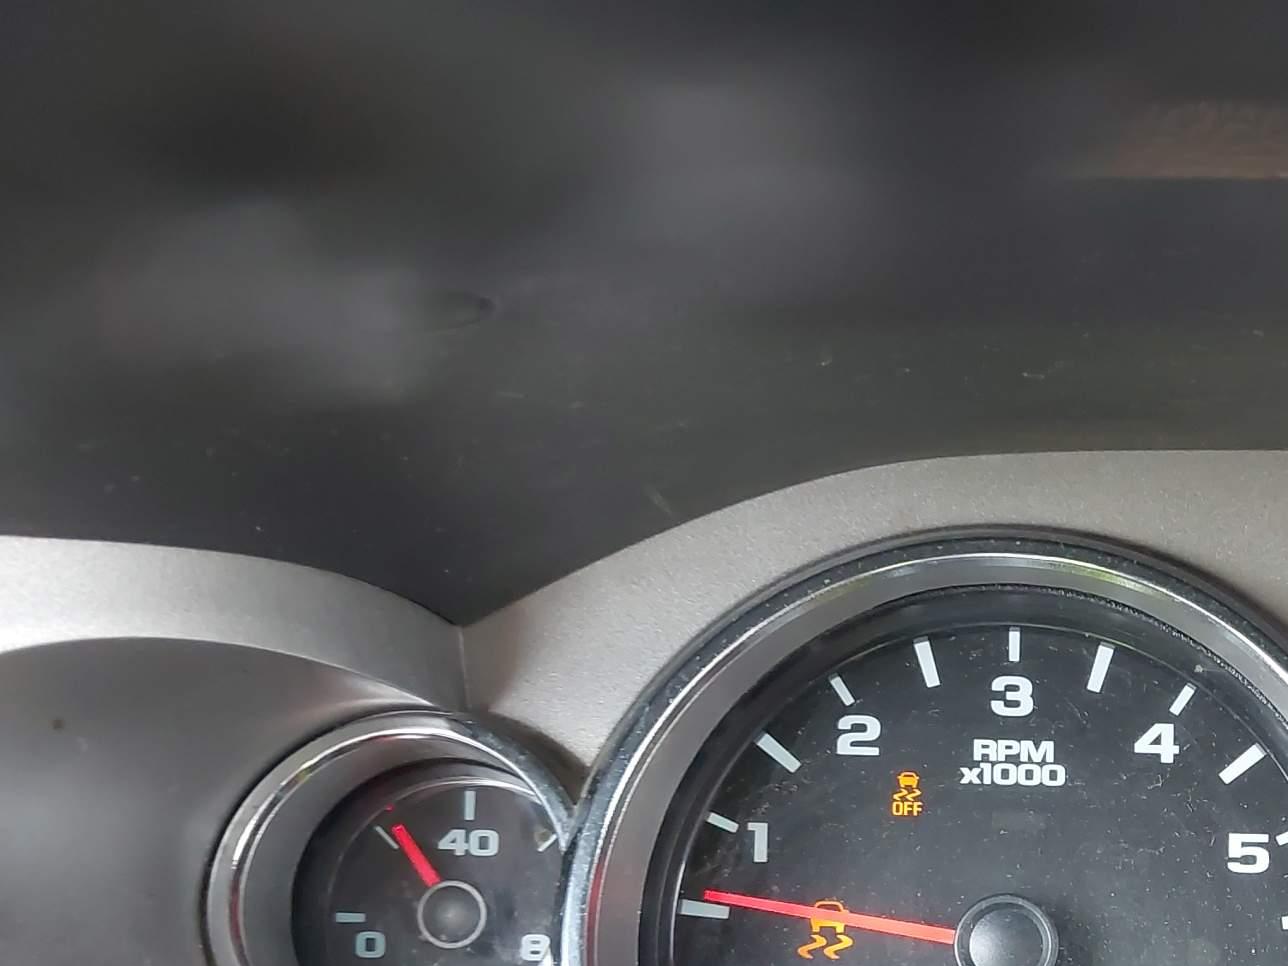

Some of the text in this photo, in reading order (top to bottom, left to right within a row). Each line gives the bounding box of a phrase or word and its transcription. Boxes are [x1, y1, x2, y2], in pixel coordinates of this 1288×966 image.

[990, 676, 1034, 717] 3
[836, 715, 881, 756] 2
[972, 740, 1055, 763] RPM
[1134, 723, 1180, 764] 4
[960, 763, 1067, 788] x1000
[892, 801, 922, 817] OFF
[438, 829, 499, 857] 40
[748, 822, 768, 862] 1
[1227, 833, 1270, 874] 5
[355, 931, 386, 959] 0
